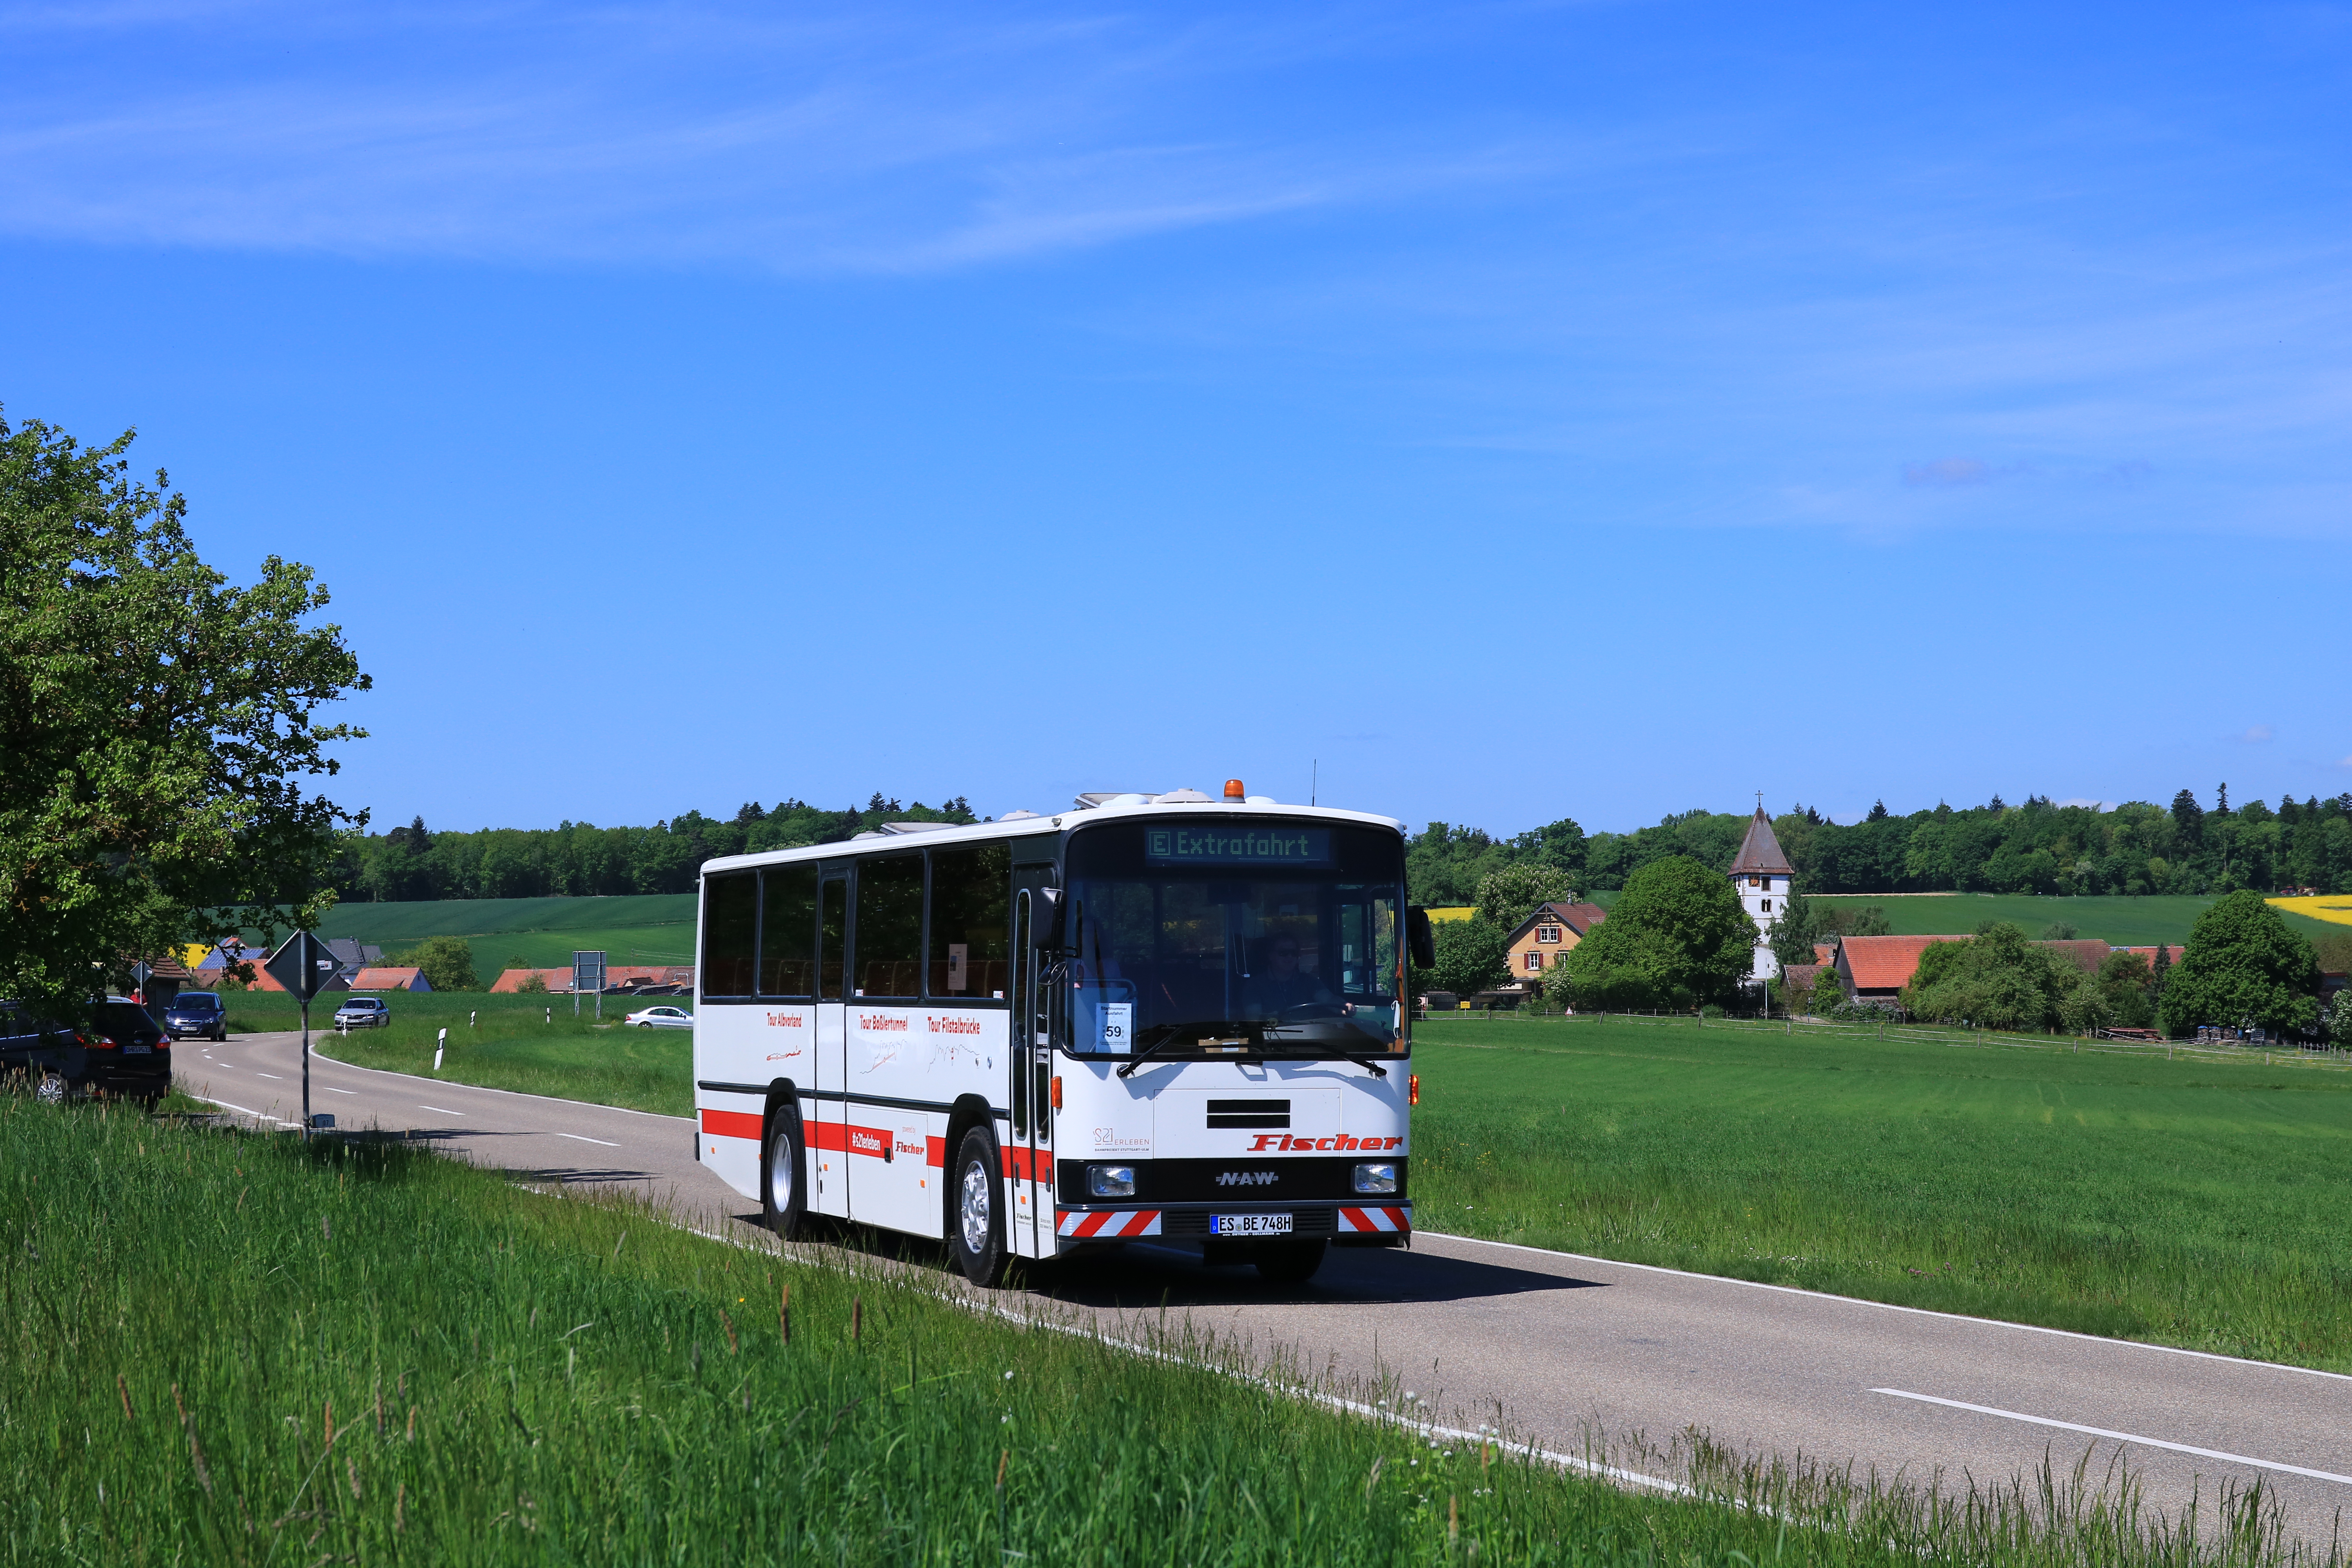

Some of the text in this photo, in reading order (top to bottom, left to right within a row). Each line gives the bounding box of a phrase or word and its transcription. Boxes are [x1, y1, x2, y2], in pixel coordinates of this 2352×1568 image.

[1153, 831, 1308, 855] E Extrafahrt
[767, 1012, 802, 1027] Tour Albvorland
[860, 1014, 908, 1032] Tour Boßlertunnel
[927, 1016, 980, 1034] Tour Filstalbrücke
[1106, 1026, 1122, 1037] 59
[852, 1132, 881, 1151] #s21erleben
[895, 1141, 925, 1155] Fischer
[1247, 1133, 1403, 1151] Fischer
[1220, 1172, 1274, 1185] NAW
[1219, 1218, 1234, 1231] ES
[1243, 1217, 1258, 1230] BE
[1261, 1216, 1291, 1230] 748H
